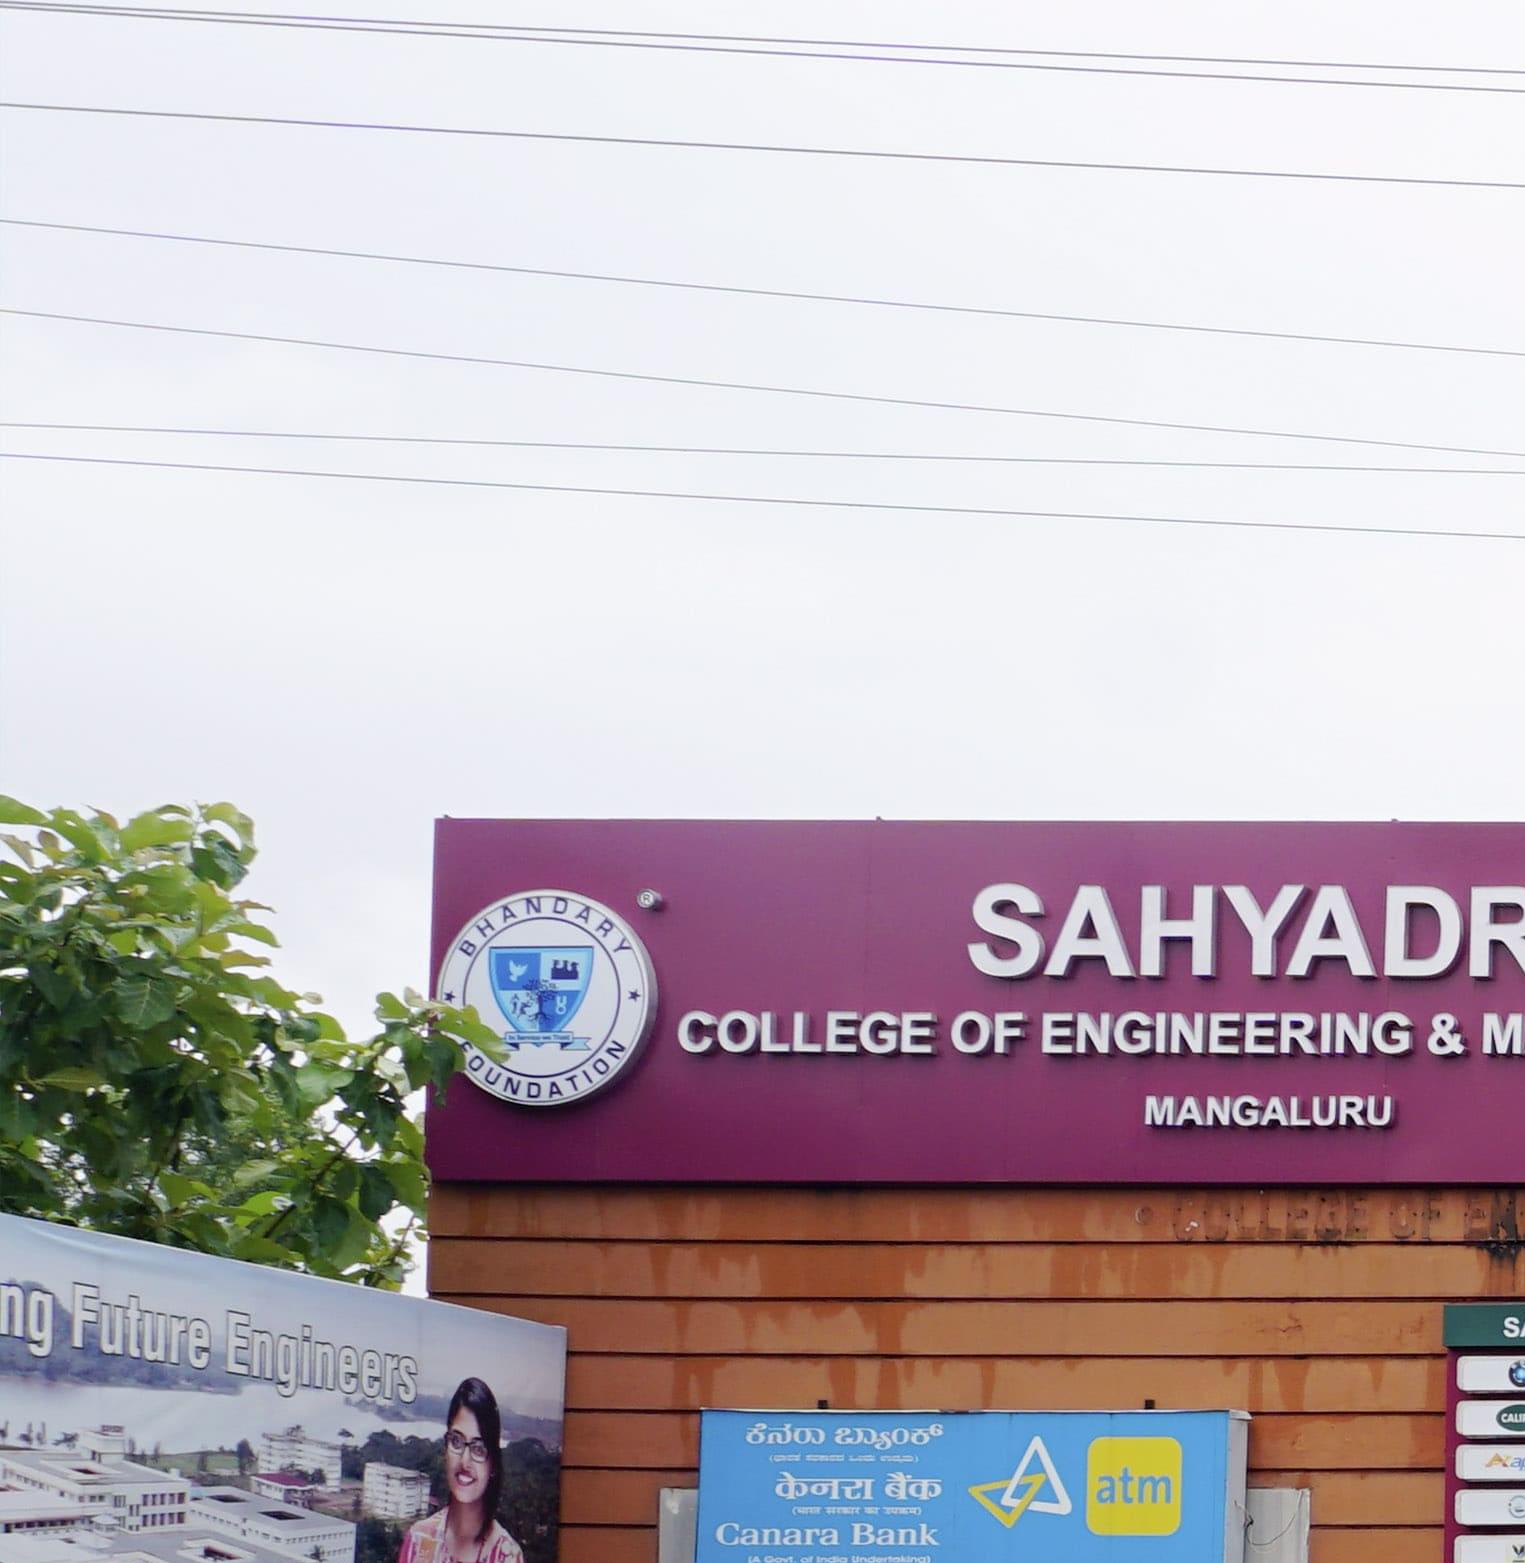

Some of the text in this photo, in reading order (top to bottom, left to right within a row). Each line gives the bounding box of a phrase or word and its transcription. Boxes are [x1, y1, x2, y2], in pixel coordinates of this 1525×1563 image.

[459, 896, 633, 957] BHANDARY
[677, 1010, 933, 1054] COLLEGE
[950, 1010, 1024, 1053] OF
[1041, 1011, 1412, 1054] ENGINEERING
[1427, 1012, 1465, 1055] &
[1144, 1095, 1392, 1126] MANGALURU
[71, 1281, 212, 1370] Future
[225, 1309, 419, 1403] Engineers
[745, 1422, 944, 1451] ಕೆನರಾ ಬ್ಯಾಂಕ್
[775, 1471, 942, 1501] केनरा बैंक
[1096, 1467, 1171, 1504] atm
[716, 1522, 940, 1546] Canara Bank
[763, 1555, 797, 1563] Govt.
[799, 1555, 814, 1563] of
[816, 1555, 849, 1563] India
